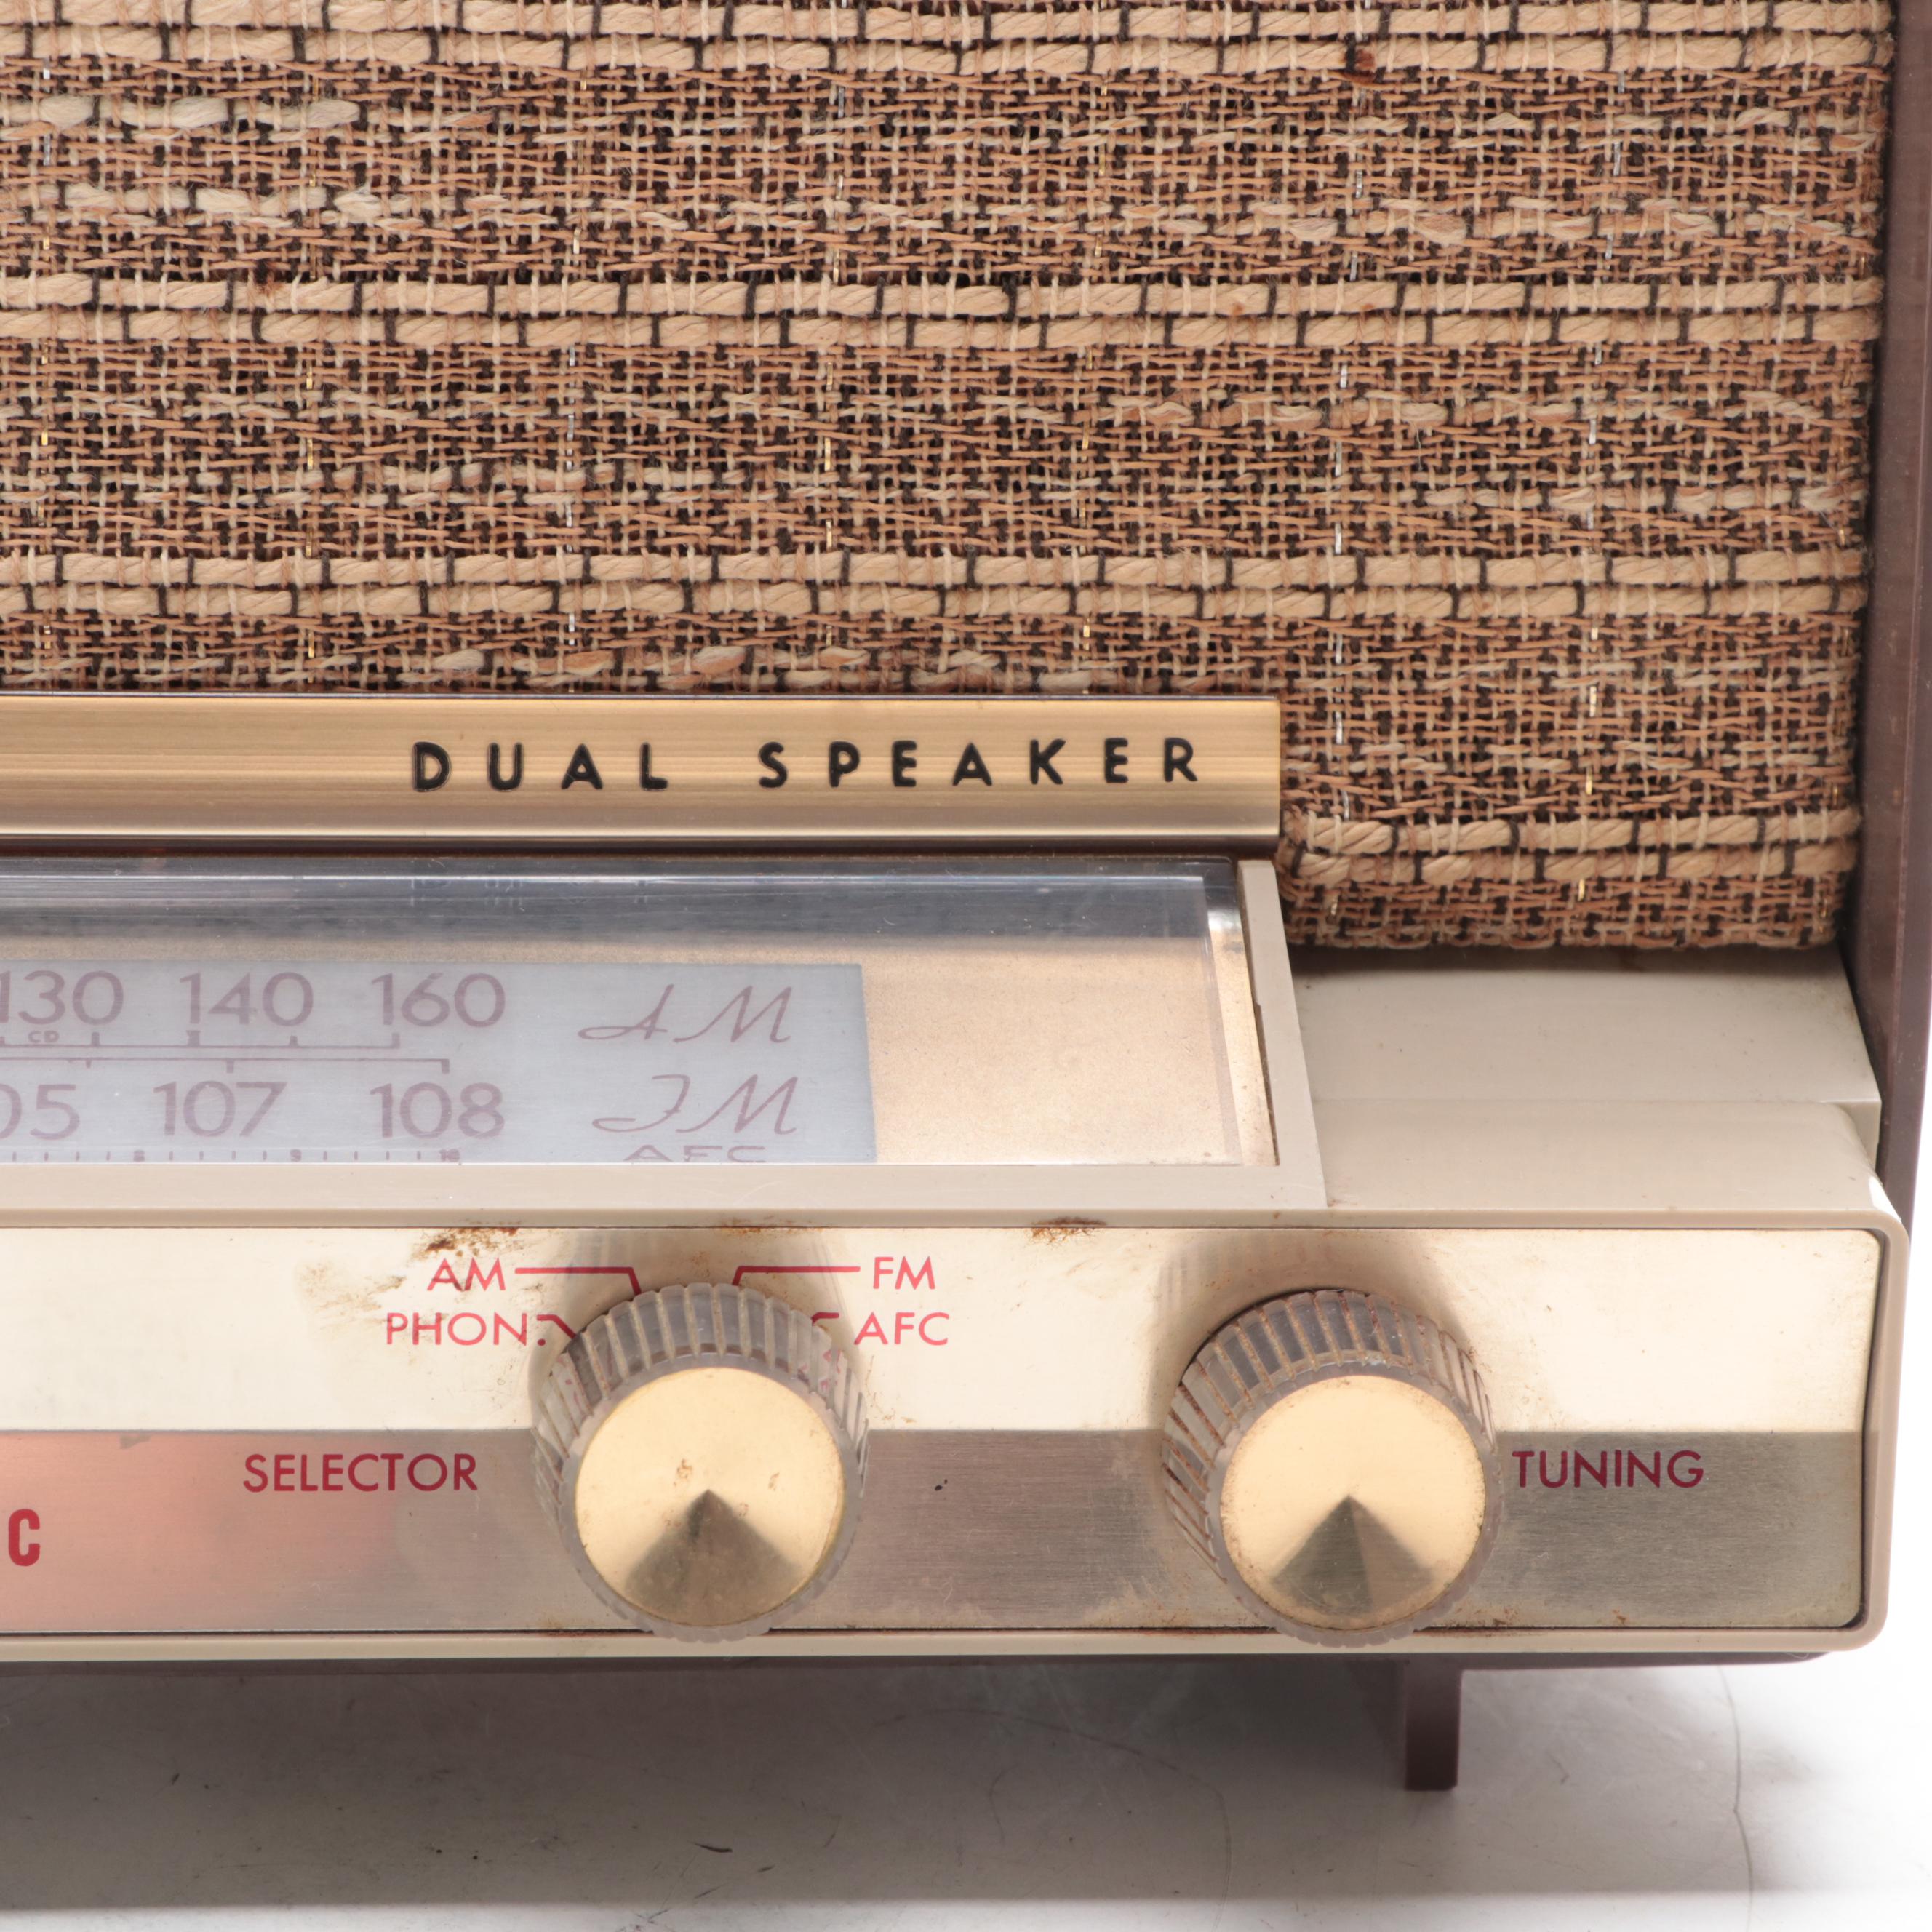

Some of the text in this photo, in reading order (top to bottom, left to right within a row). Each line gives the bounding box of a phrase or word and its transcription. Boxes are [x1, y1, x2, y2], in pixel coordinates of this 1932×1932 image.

[412, 737, 1198, 792] DUAL SPEAKER
[179, 971, 314, 1027] 140
[371, 972, 506, 1028] 160
[578, 983, 792, 1043] AM
[153, 1080, 288, 1137] 107
[370, 1082, 505, 1139] 108
[623, 1145, 766, 1163] AFC
[427, 1257, 507, 1291] AM
[874, 1256, 937, 1290] FM
[386, 1313, 547, 1346] PHON.
[854, 1312, 951, 1345] AFC
[242, 1453, 478, 1493] SELECTOR
[1512, 1449, 1704, 1488] TUNING
[8, 1509, 41, 1566] C
